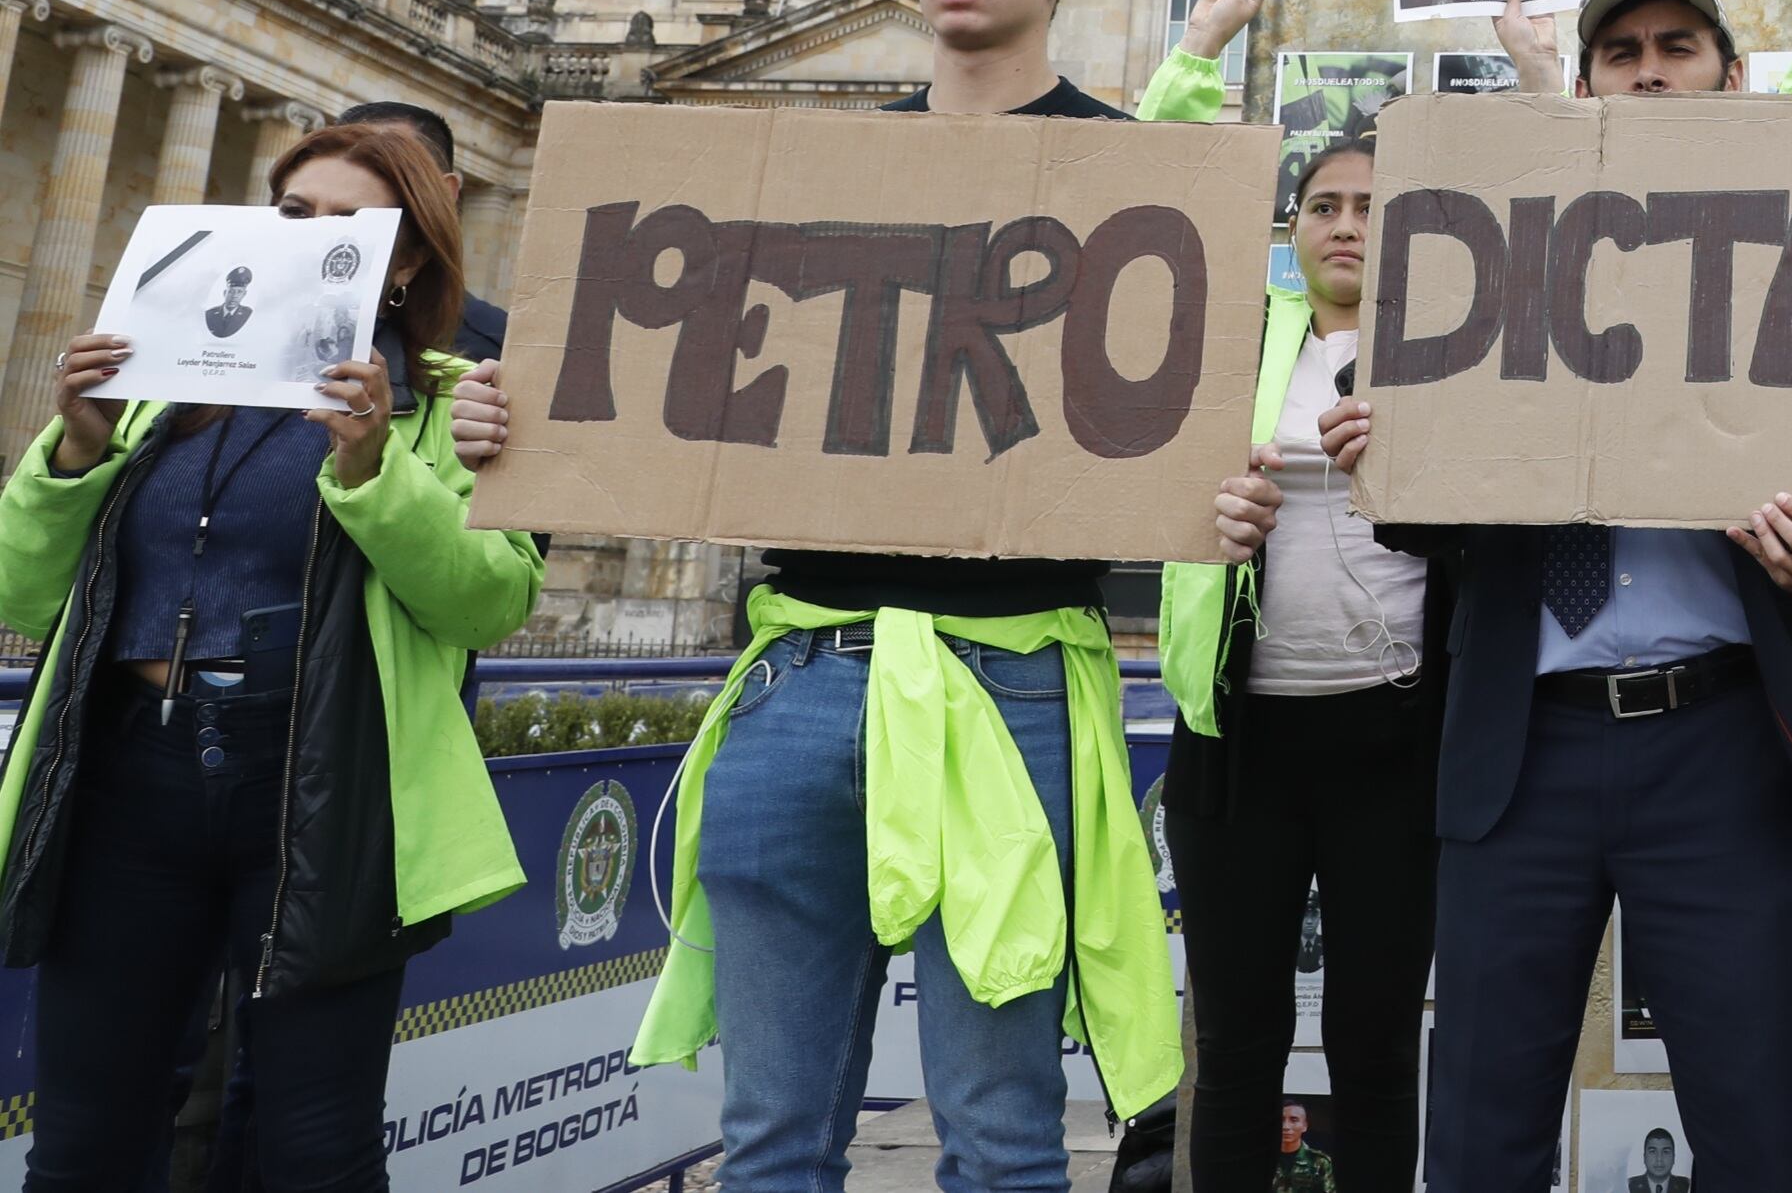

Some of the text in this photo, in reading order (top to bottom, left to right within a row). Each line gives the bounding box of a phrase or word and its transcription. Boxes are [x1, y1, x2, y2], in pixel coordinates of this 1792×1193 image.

[548, 200, 1208, 463] PETRO
[383, 1085, 486, 1156] OLICÍA
[459, 1081, 640, 1187] DE BOGOTÁ
